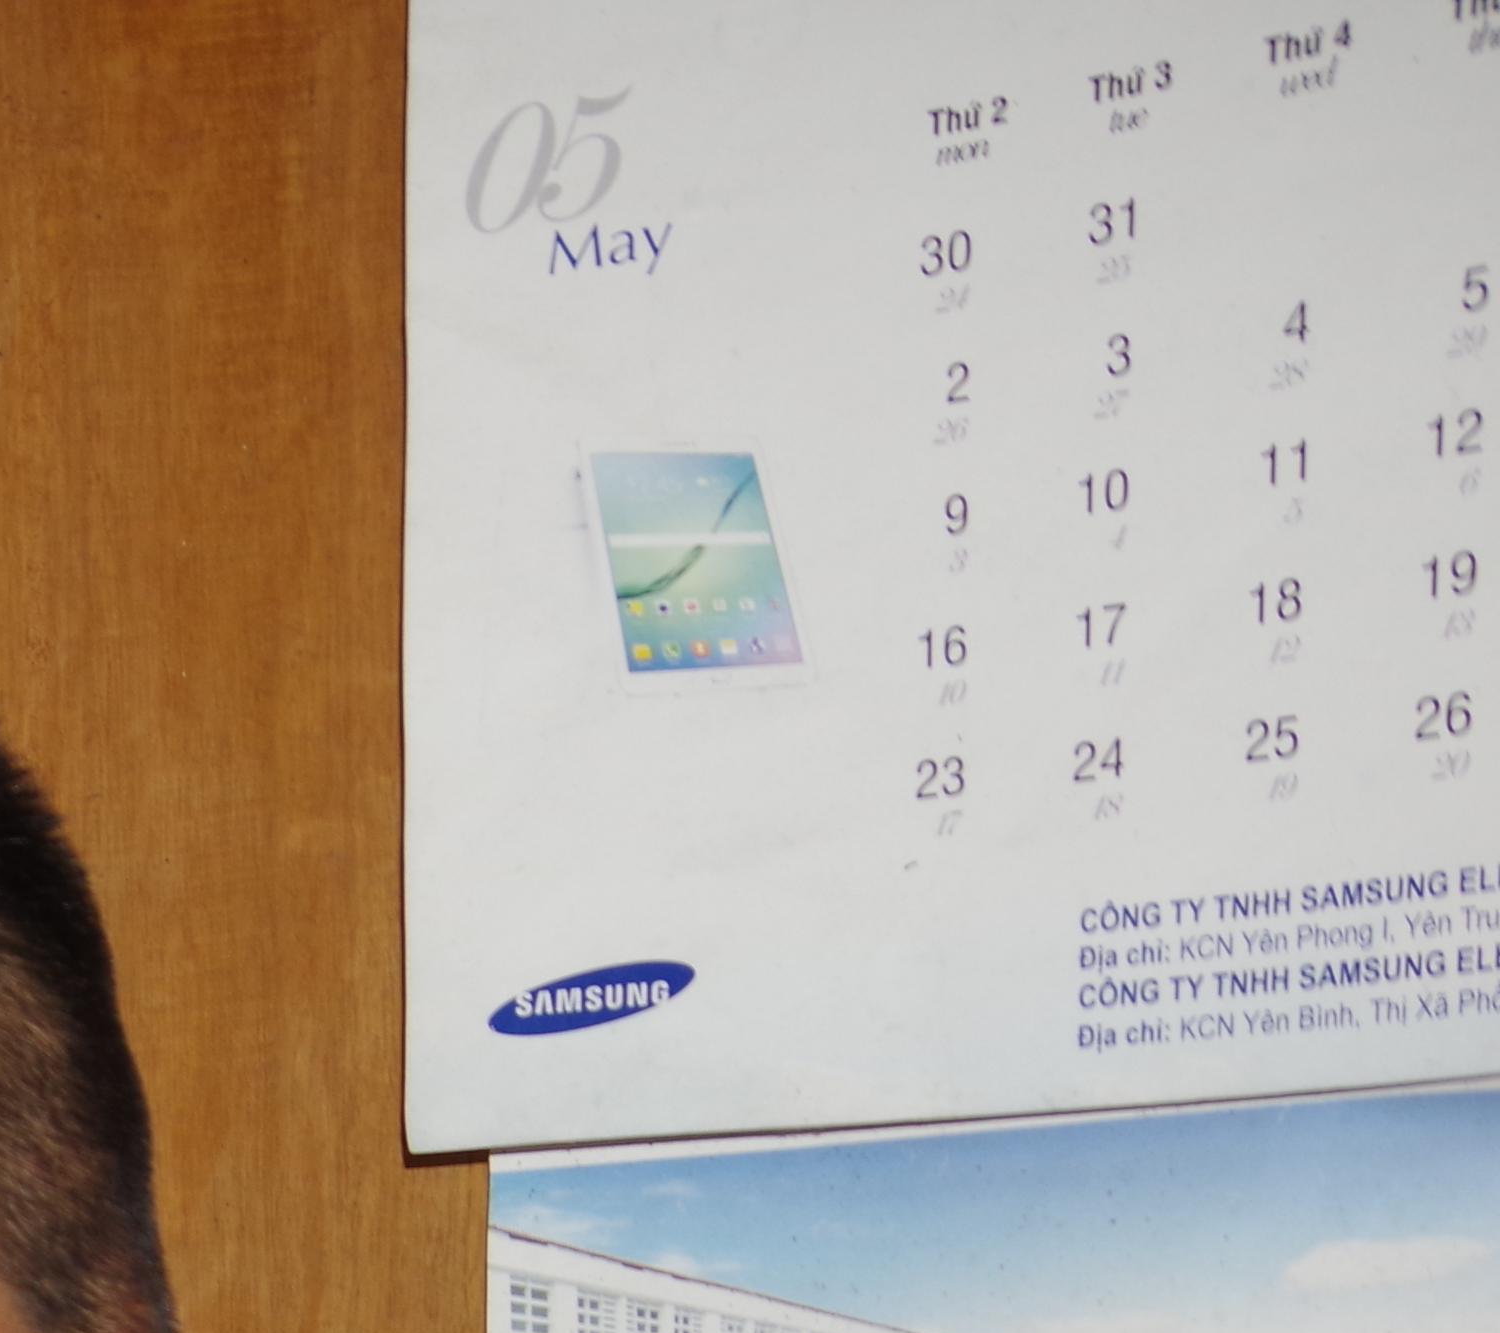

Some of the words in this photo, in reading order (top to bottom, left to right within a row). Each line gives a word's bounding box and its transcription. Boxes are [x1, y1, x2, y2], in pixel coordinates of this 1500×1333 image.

[1266, 30, 1322, 65] Thứ
[1334, 20, 1352, 48] 4
[1089, 68, 1144, 103] Thứ
[1154, 61, 1172, 90] 3
[928, 103, 982, 136] Thứ
[991, 96, 1008, 125] 2
[465, 84, 633, 234] 05
[936, 139, 990, 166] mon
[1088, 198, 1135, 245] 31
[549, 224, 671, 275] May
[920, 230, 972, 277] 30
[1462, 266, 1489, 312] 5
[1283, 301, 1308, 342] 4
[1107, 334, 1132, 377] 3
[946, 361, 970, 404] 2
[1431, 408, 1484, 458] 12
[1265, 439, 1307, 486] 11
[944, 494, 969, 535] 9
[1082, 469, 1129, 514] 10
[1427, 551, 1478, 598] 19
[1255, 578, 1302, 624] 18
[920, 625, 967, 668] 16
[1077, 602, 1127, 648] 17
[1245, 715, 1299, 762] 25
[1415, 692, 1472, 740] 26
[915, 756, 965, 800] 23
[1073, 737, 1123, 783] 24
[1081, 900, 1161, 933] CÔNG
[1171, 898, 1203, 926] TY
[1214, 888, 1291, 921] TNHH
[1301, 868, 1448, 912] SAMSUNG
[1079, 944, 1117, 973] Địa
[1179, 933, 1233, 962] KCN
[1242, 929, 1288, 955] Yên
[1299, 922, 1374, 951] Phong
[514, 979, 670, 1017] SAMSUNG
